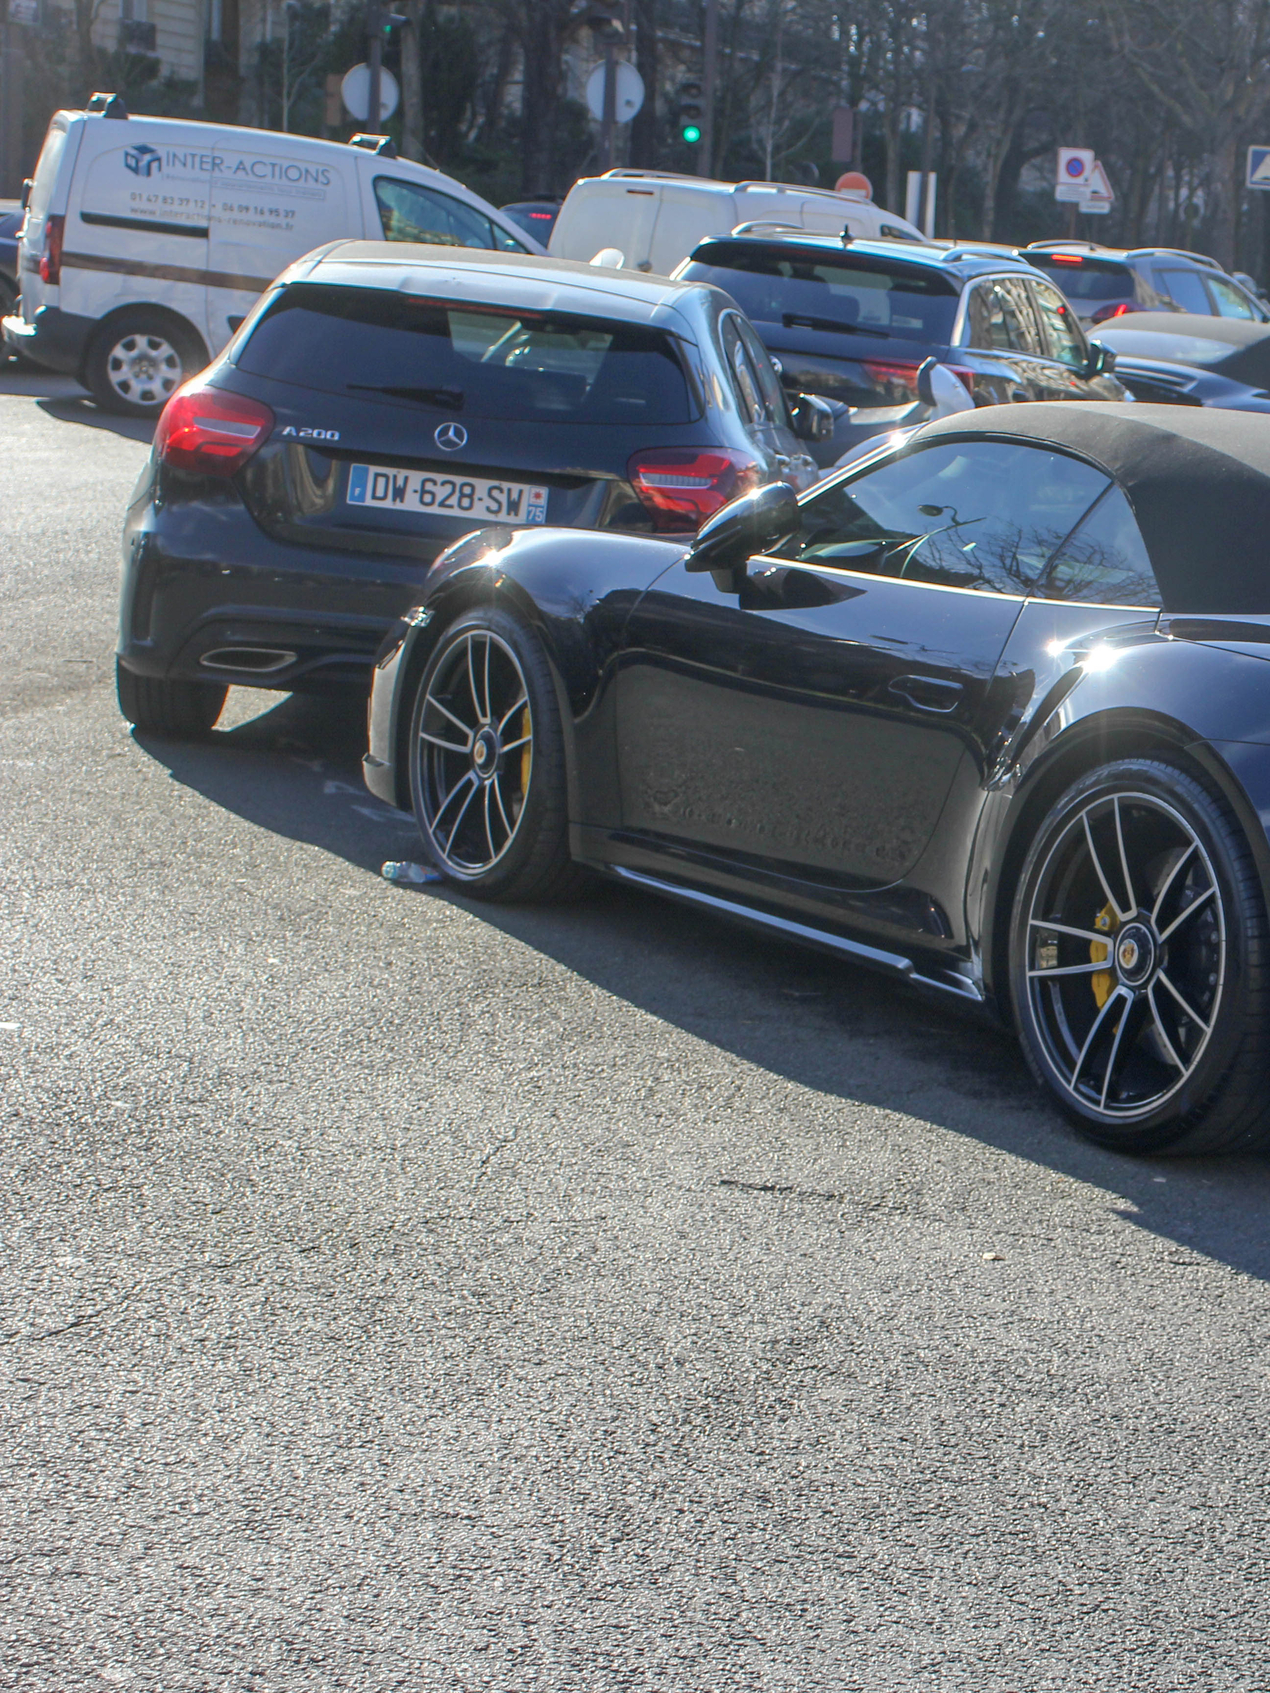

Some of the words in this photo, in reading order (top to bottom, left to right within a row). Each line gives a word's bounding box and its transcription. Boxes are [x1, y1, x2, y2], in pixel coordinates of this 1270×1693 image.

[166, 150, 331, 186] INTER-ACTIONS
[282, 426, 297, 437] A
[299, 427, 341, 441] 200
[527, 506, 543, 522] 75
